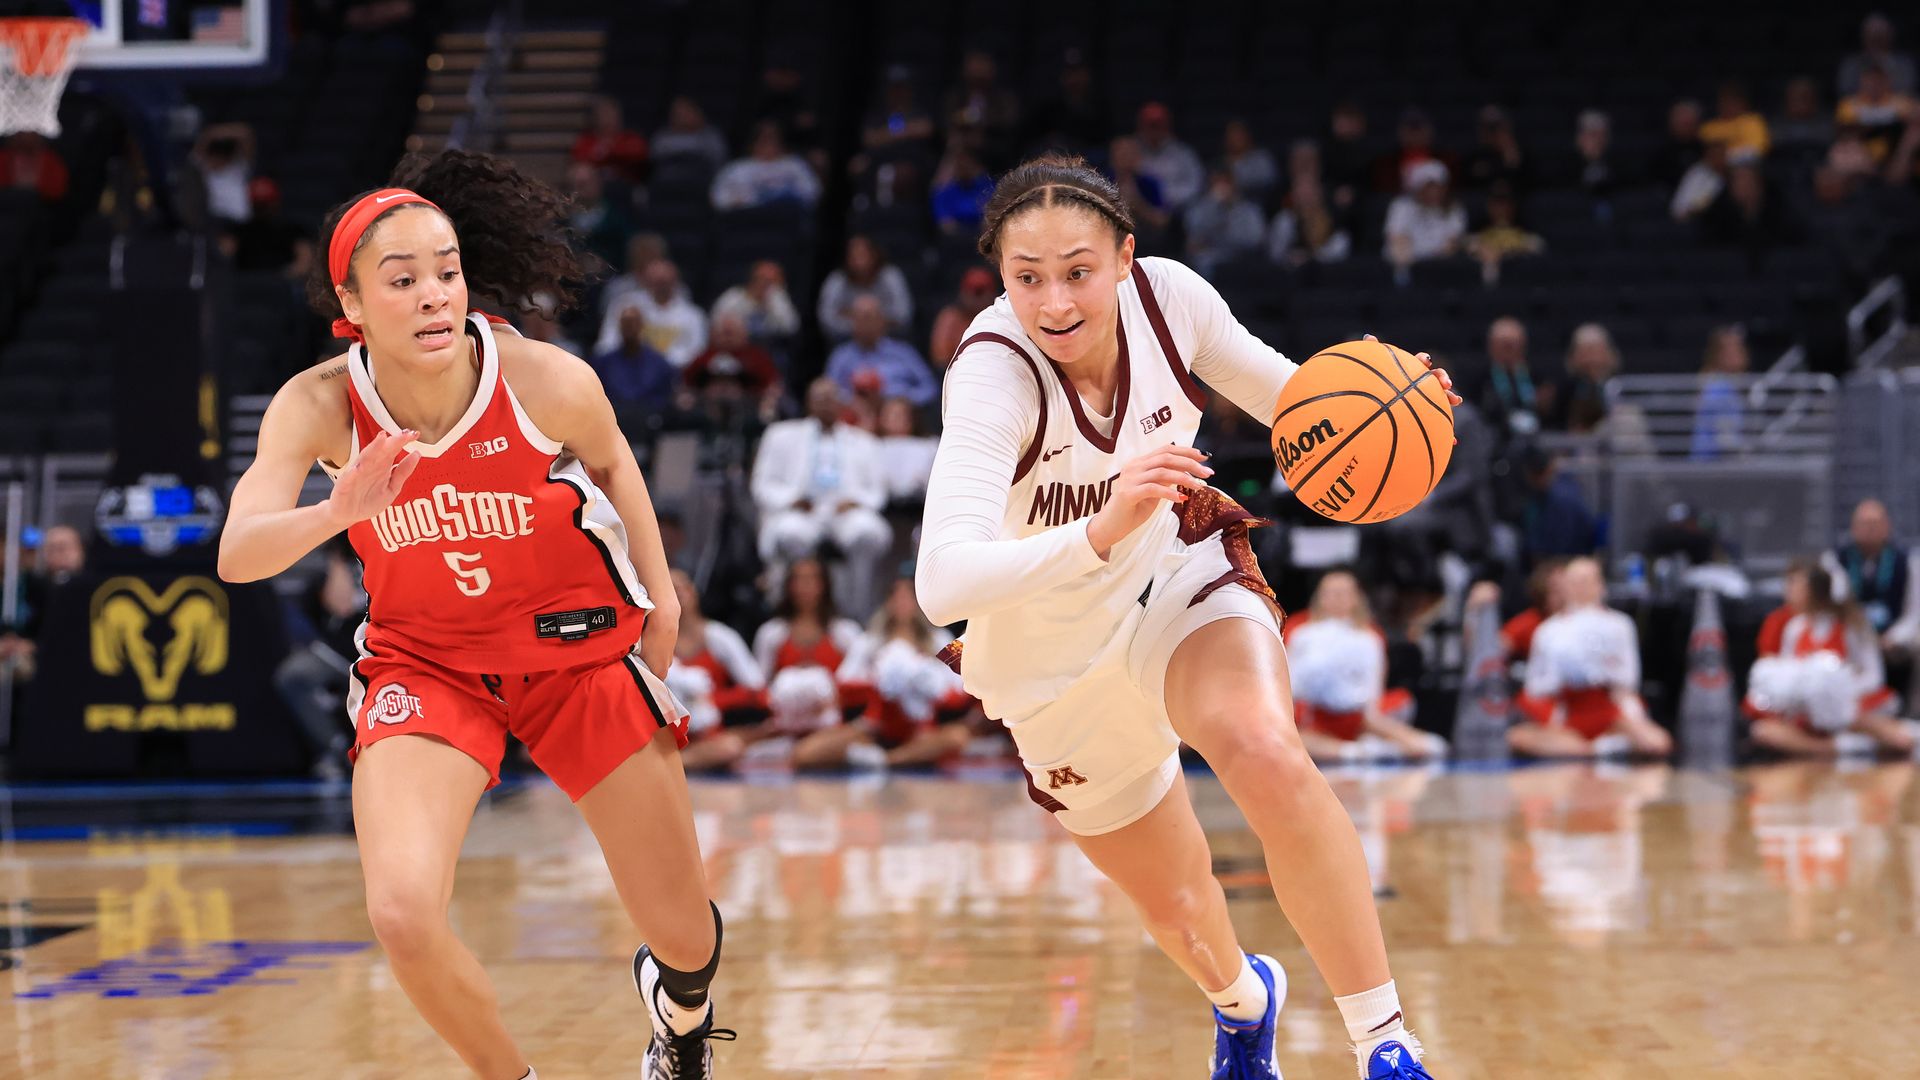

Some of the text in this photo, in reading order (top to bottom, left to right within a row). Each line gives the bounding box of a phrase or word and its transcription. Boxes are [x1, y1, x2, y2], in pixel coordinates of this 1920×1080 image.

[1342, 456, 1359, 479] NXT
[442, 551, 491, 597] 5
[591, 614, 605, 625] 40
[85, 703, 236, 731] RAM
[1046, 765, 1088, 790] M
